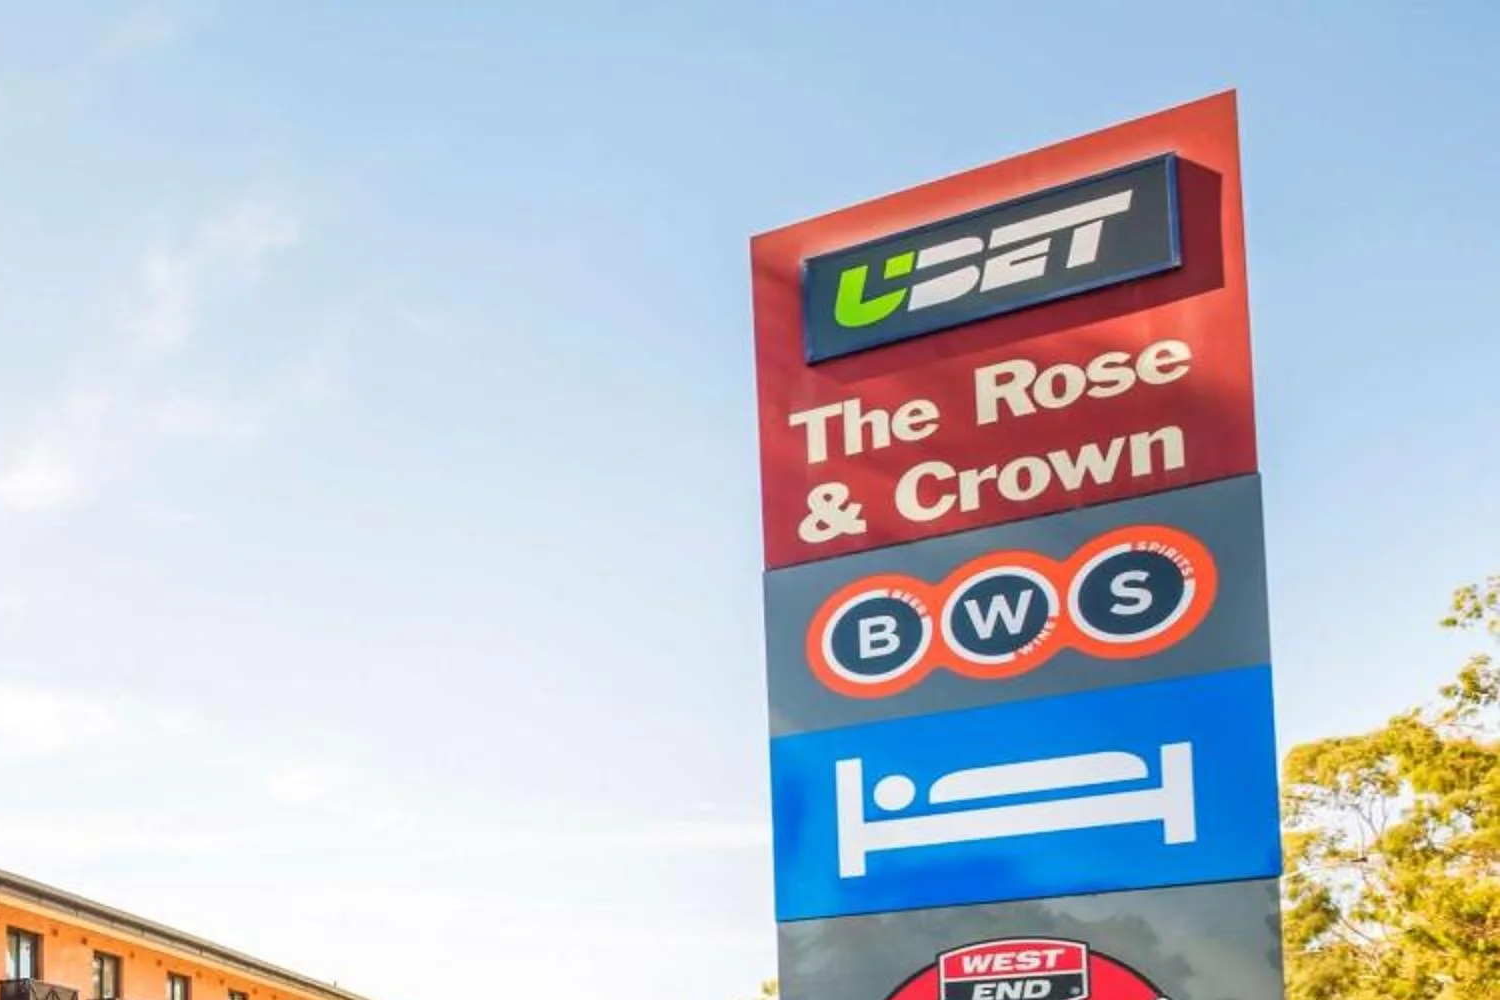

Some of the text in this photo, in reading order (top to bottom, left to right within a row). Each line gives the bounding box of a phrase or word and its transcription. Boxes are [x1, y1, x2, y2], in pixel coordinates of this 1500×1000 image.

[834, 189, 1132, 327] UBET
[789, 339, 1192, 464] The Rose
[798, 425, 1185, 543] & Crown
[1136, 541, 1194, 576] SPIRITS
[962, 948, 1066, 975] WEST
